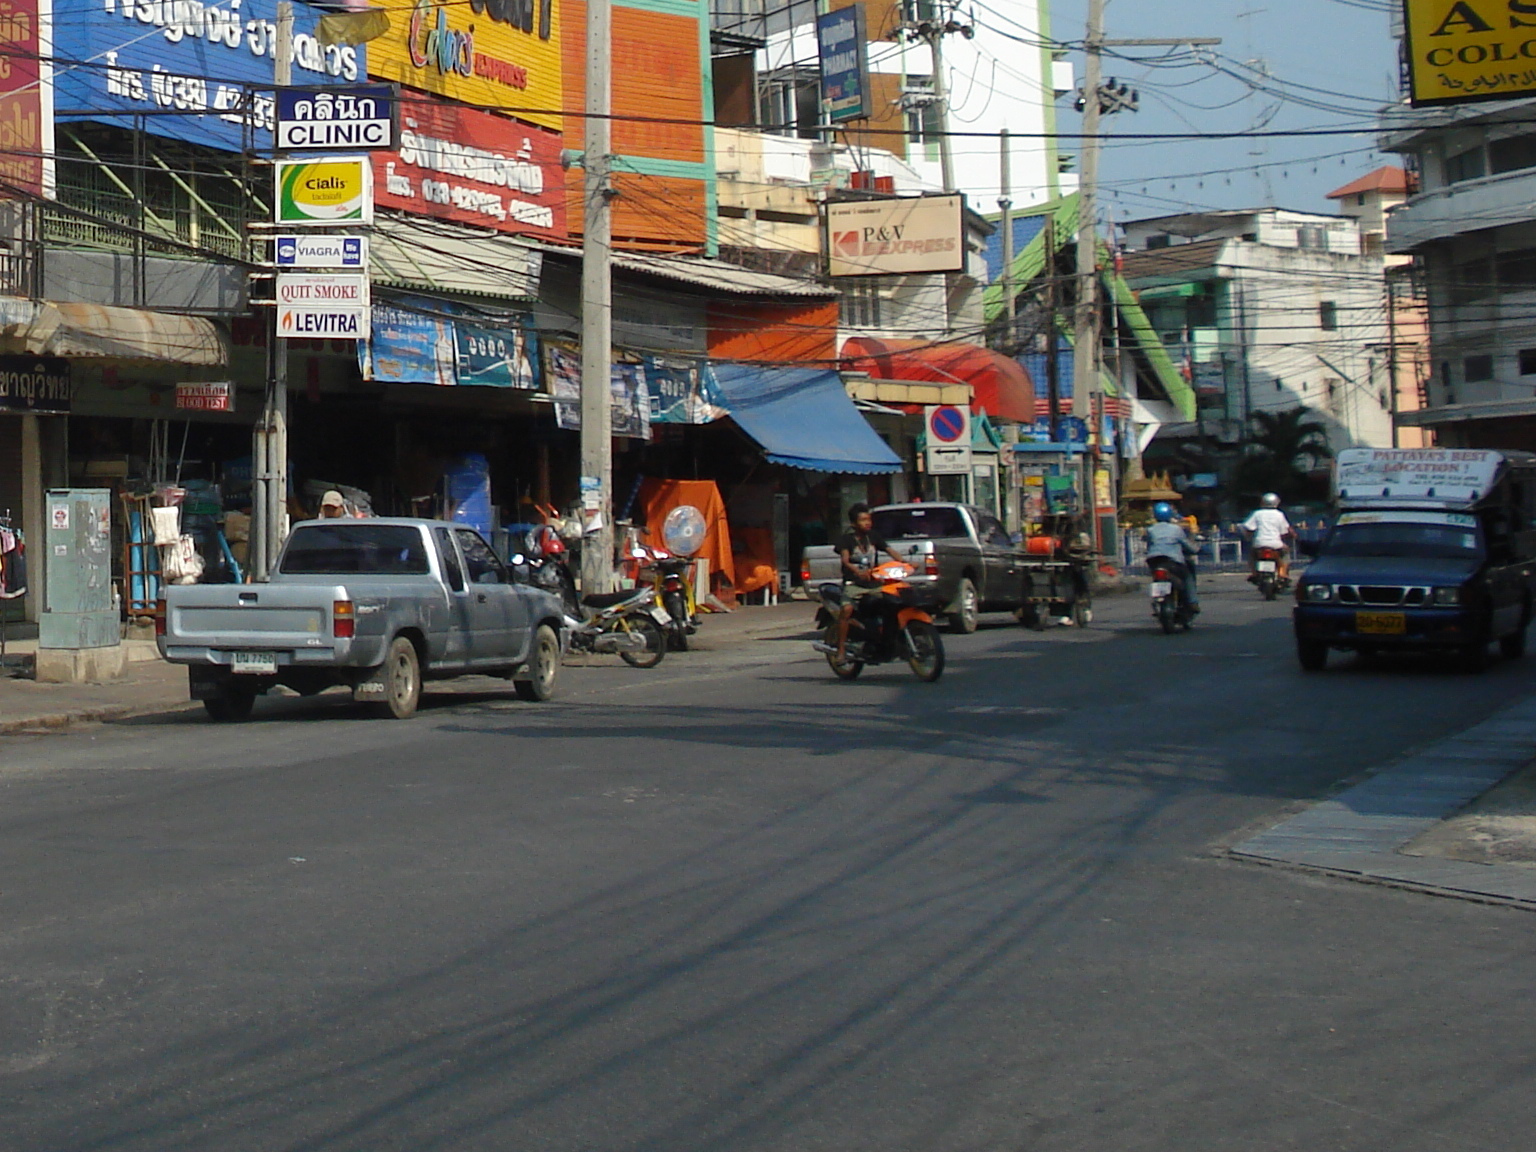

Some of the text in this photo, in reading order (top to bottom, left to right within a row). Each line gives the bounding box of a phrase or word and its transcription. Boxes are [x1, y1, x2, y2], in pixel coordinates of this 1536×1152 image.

[293, 92, 376, 121] คลินิก
[286, 122, 383, 146] CLINIC
[305, 175, 346, 191] Cialis
[298, 246, 340, 257] VIAGRA
[281, 284, 358, 302] QUIT SMOKE
[295, 313, 358, 333] LEVITRA
[205, 396, 227, 409] TEST
[1451, 450, 1490, 462] BEST
[1383, 462, 1460, 473] LOCATION
